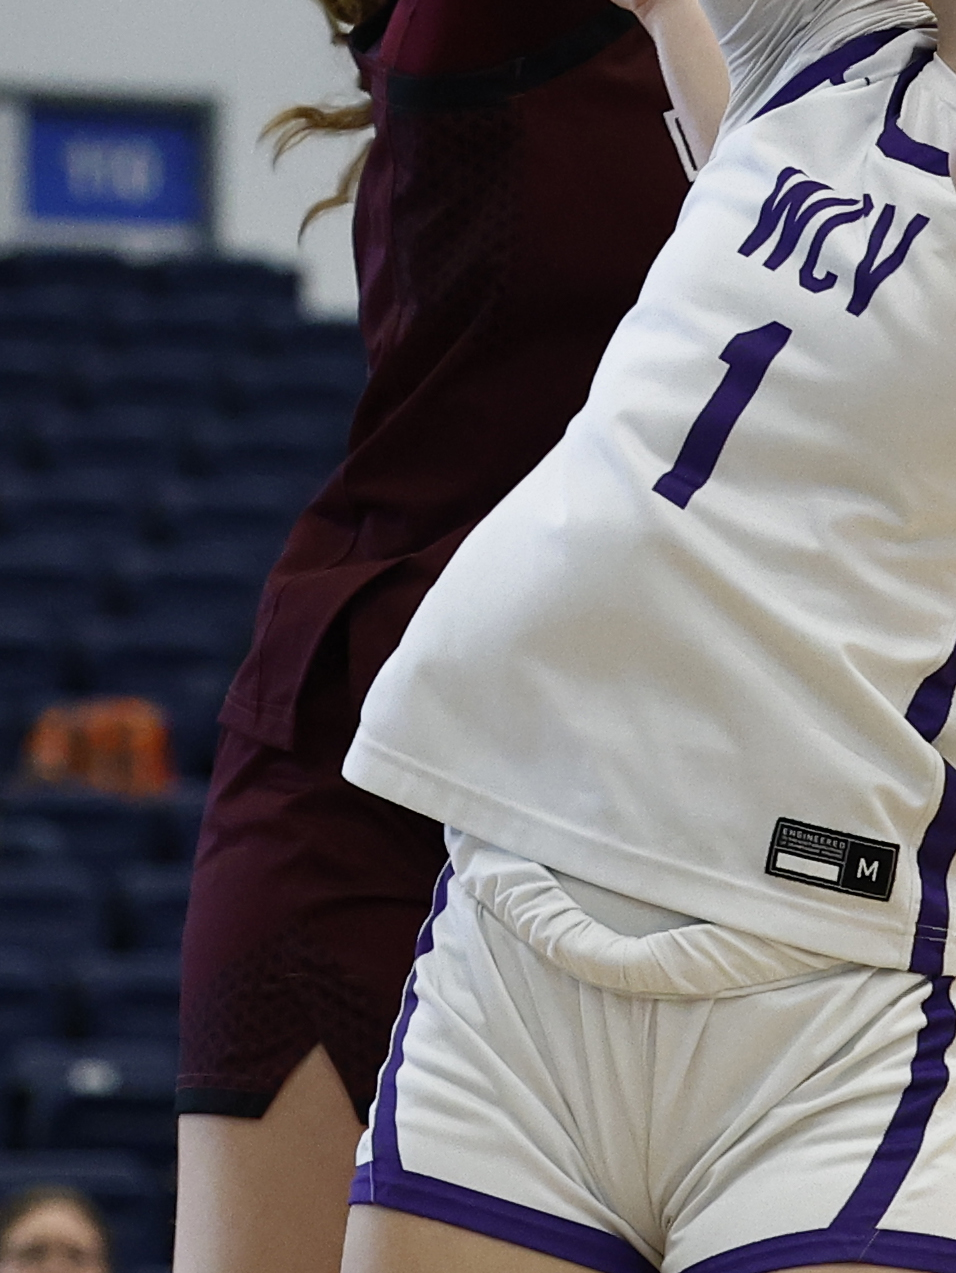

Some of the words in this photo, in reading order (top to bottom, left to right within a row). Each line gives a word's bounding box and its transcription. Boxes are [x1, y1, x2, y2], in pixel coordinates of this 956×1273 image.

[738, 166, 931, 317] WCV
[652, 321, 792, 510] 1
[781, 827, 846, 849] ENGINEERED
[856, 857, 880, 882] M
